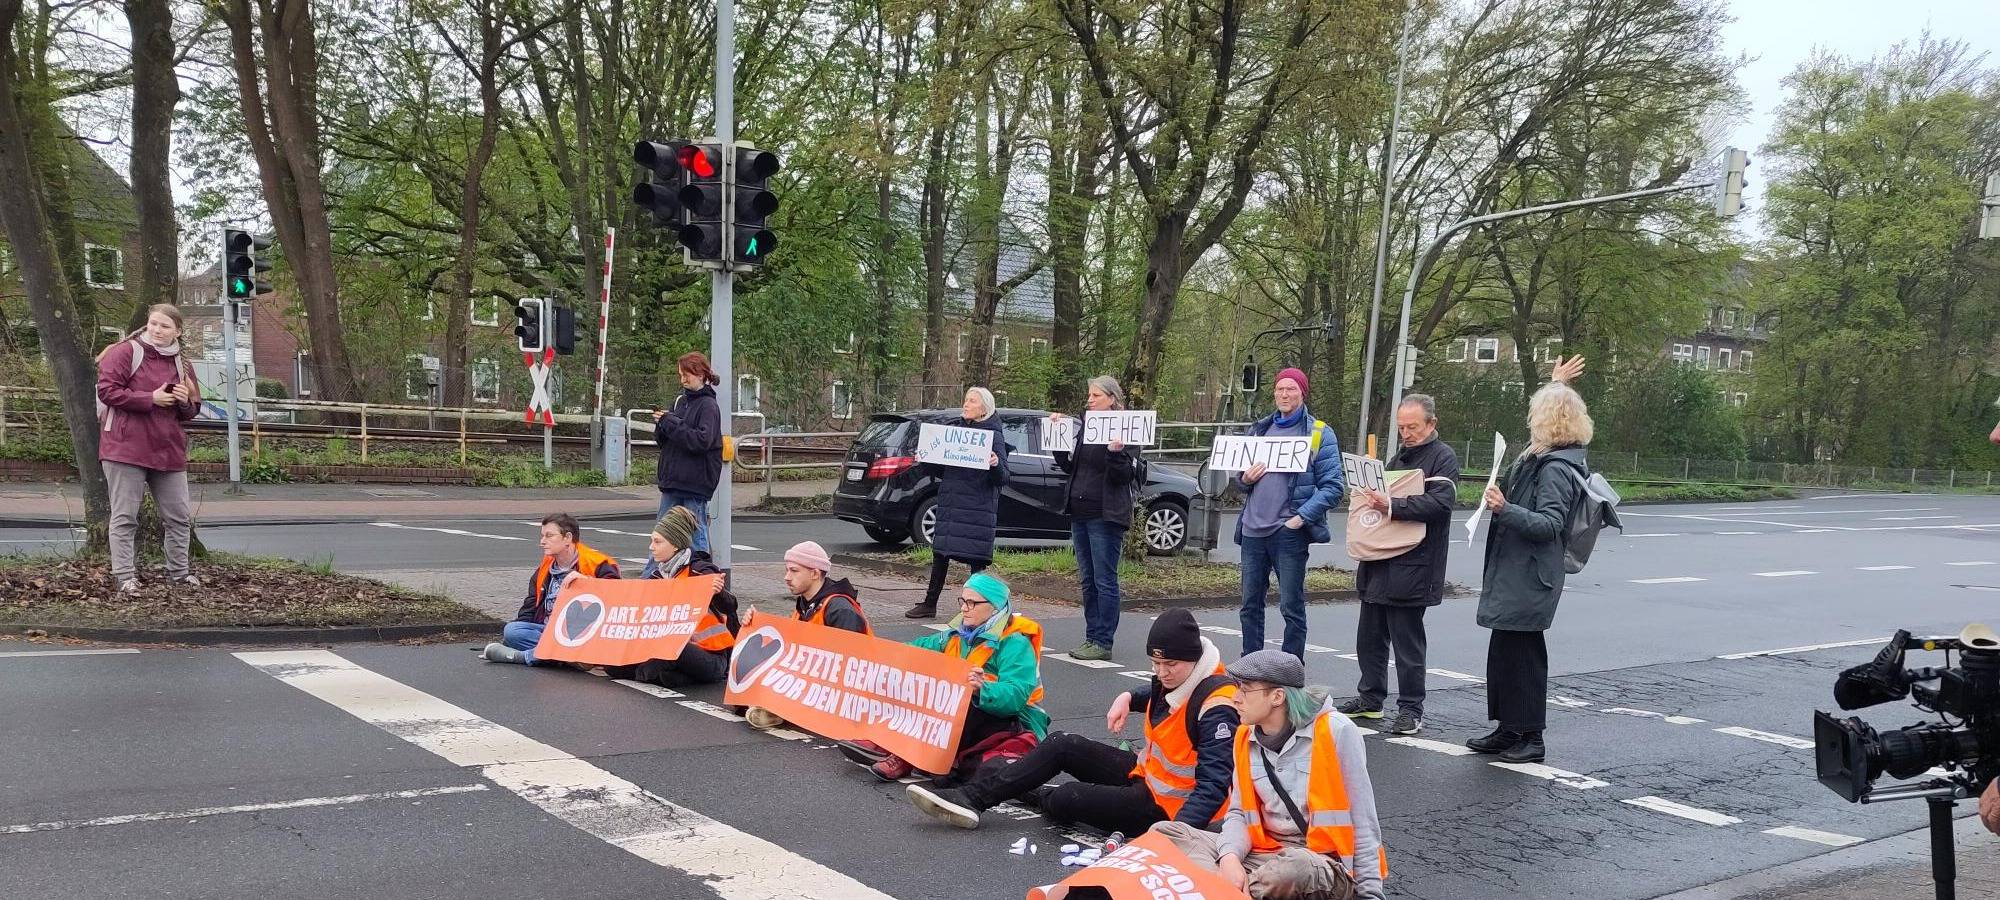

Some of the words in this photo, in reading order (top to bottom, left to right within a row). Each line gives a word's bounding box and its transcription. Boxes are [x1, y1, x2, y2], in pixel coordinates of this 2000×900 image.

[944, 427, 987, 447] UNSER
[1086, 415, 1153, 443] STEHEN
[1344, 457, 1386, 492] EUCH
[606, 606, 639, 624] ART.
[640, 605, 669, 623] 20A
[669, 603, 691, 621] GG
[600, 623, 640, 640] LEBEN
[779, 643, 844, 683] LETZTE
[843, 656, 966, 717] GENERATION
[761, 668, 808, 701] VOR
[802, 683, 841, 715] DEN
[839, 692, 953, 750] KIPPPUNKTEN
